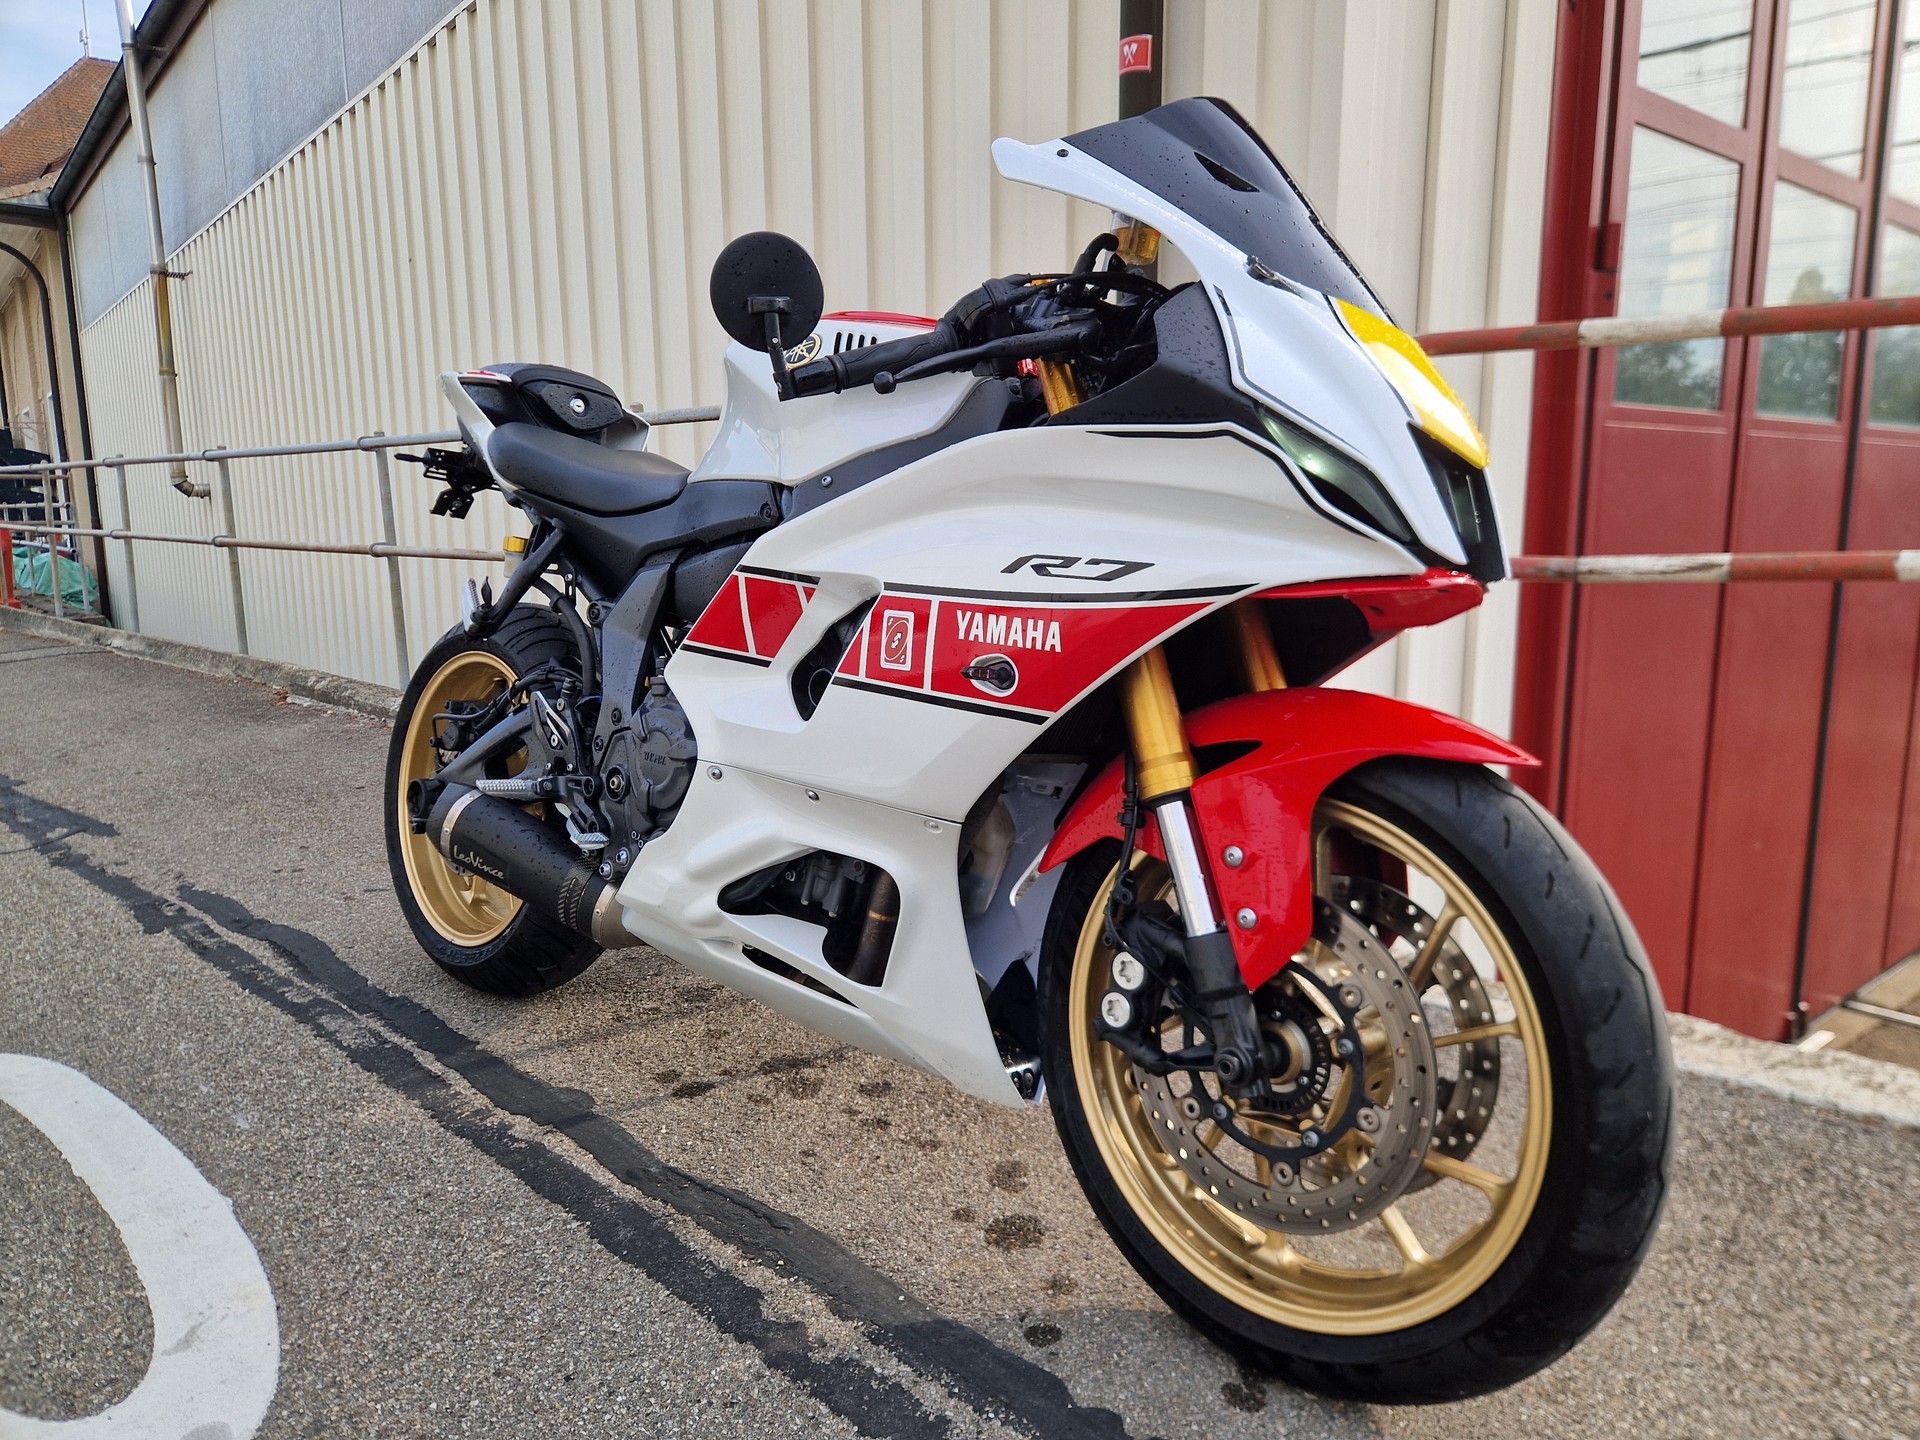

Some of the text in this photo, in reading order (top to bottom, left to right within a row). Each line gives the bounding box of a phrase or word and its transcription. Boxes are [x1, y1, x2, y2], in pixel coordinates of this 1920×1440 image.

[1000, 554, 1155, 581] R7
[956, 609, 1062, 653] YAMAHA
[453, 845, 504, 879] LeoVince
